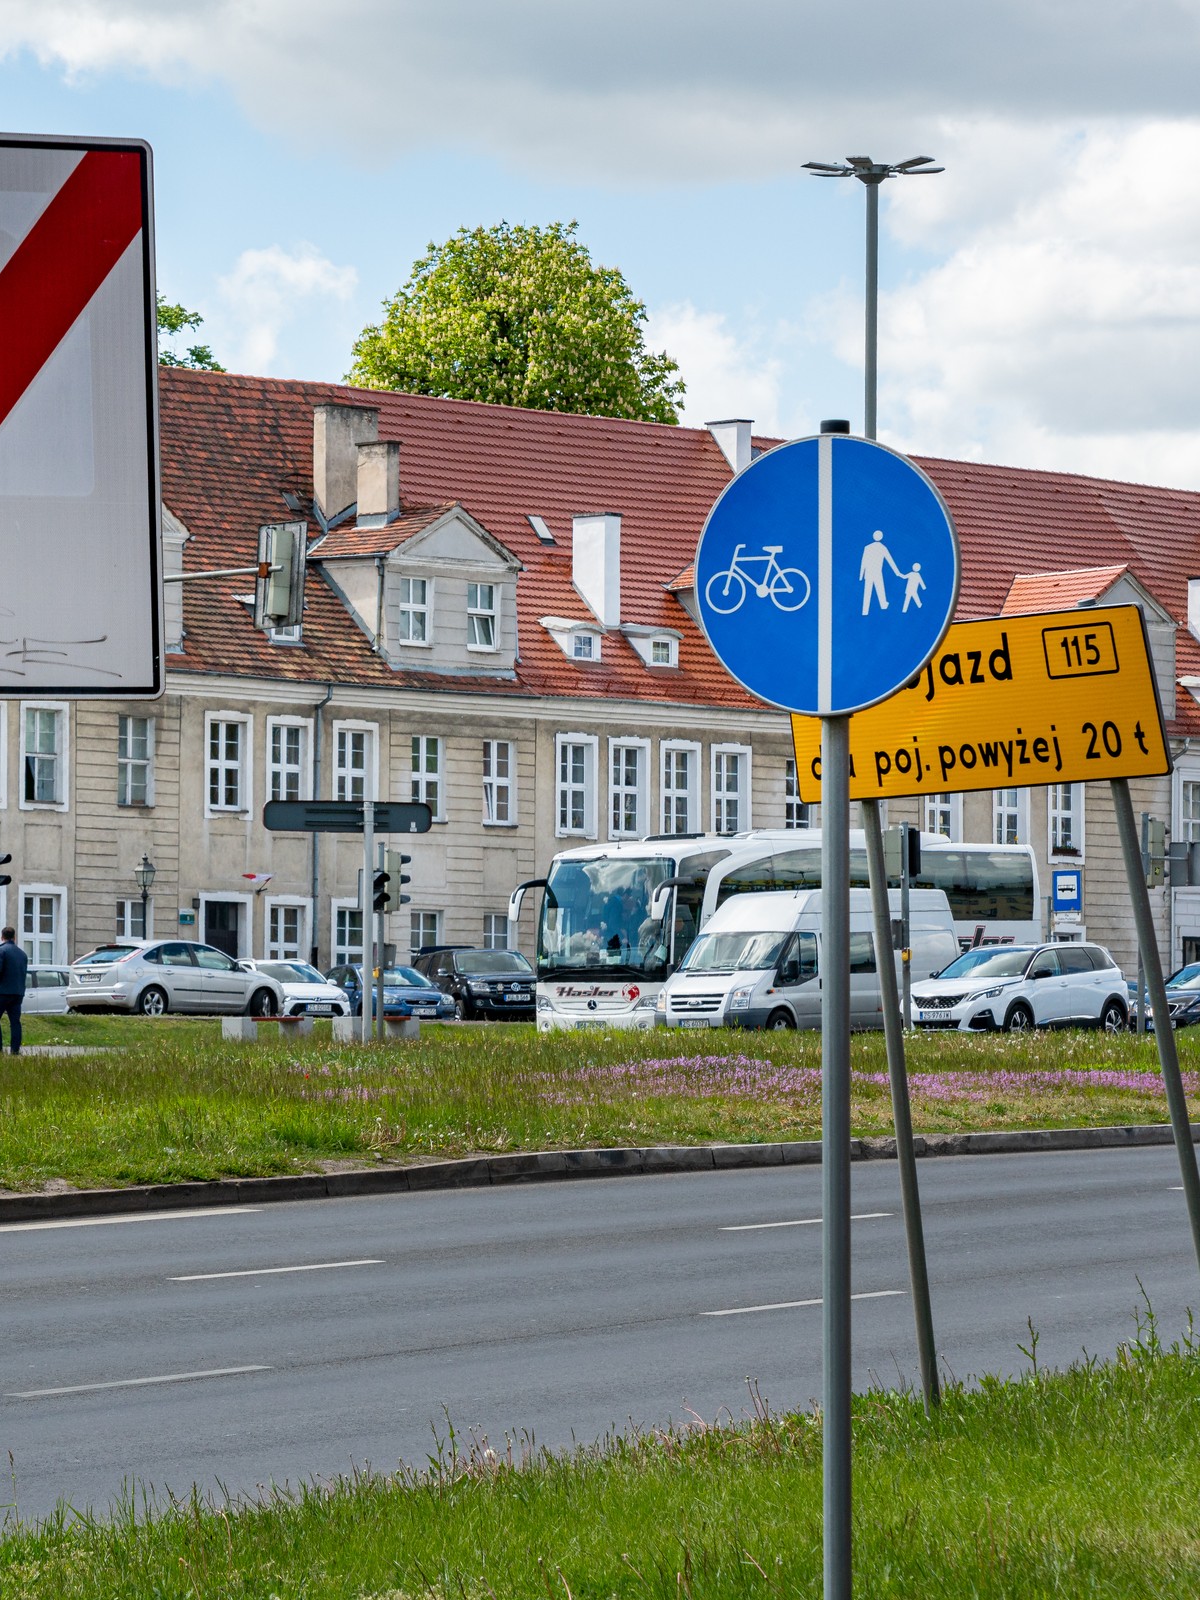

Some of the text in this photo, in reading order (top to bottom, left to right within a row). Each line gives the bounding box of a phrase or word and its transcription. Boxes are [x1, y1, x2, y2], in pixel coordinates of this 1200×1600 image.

[904, 632, 1102, 702] jazd 115
[1081, 719, 1123, 760] 20
[1134, 720, 1150, 756] t
[557, 985, 618, 997] Hasler
